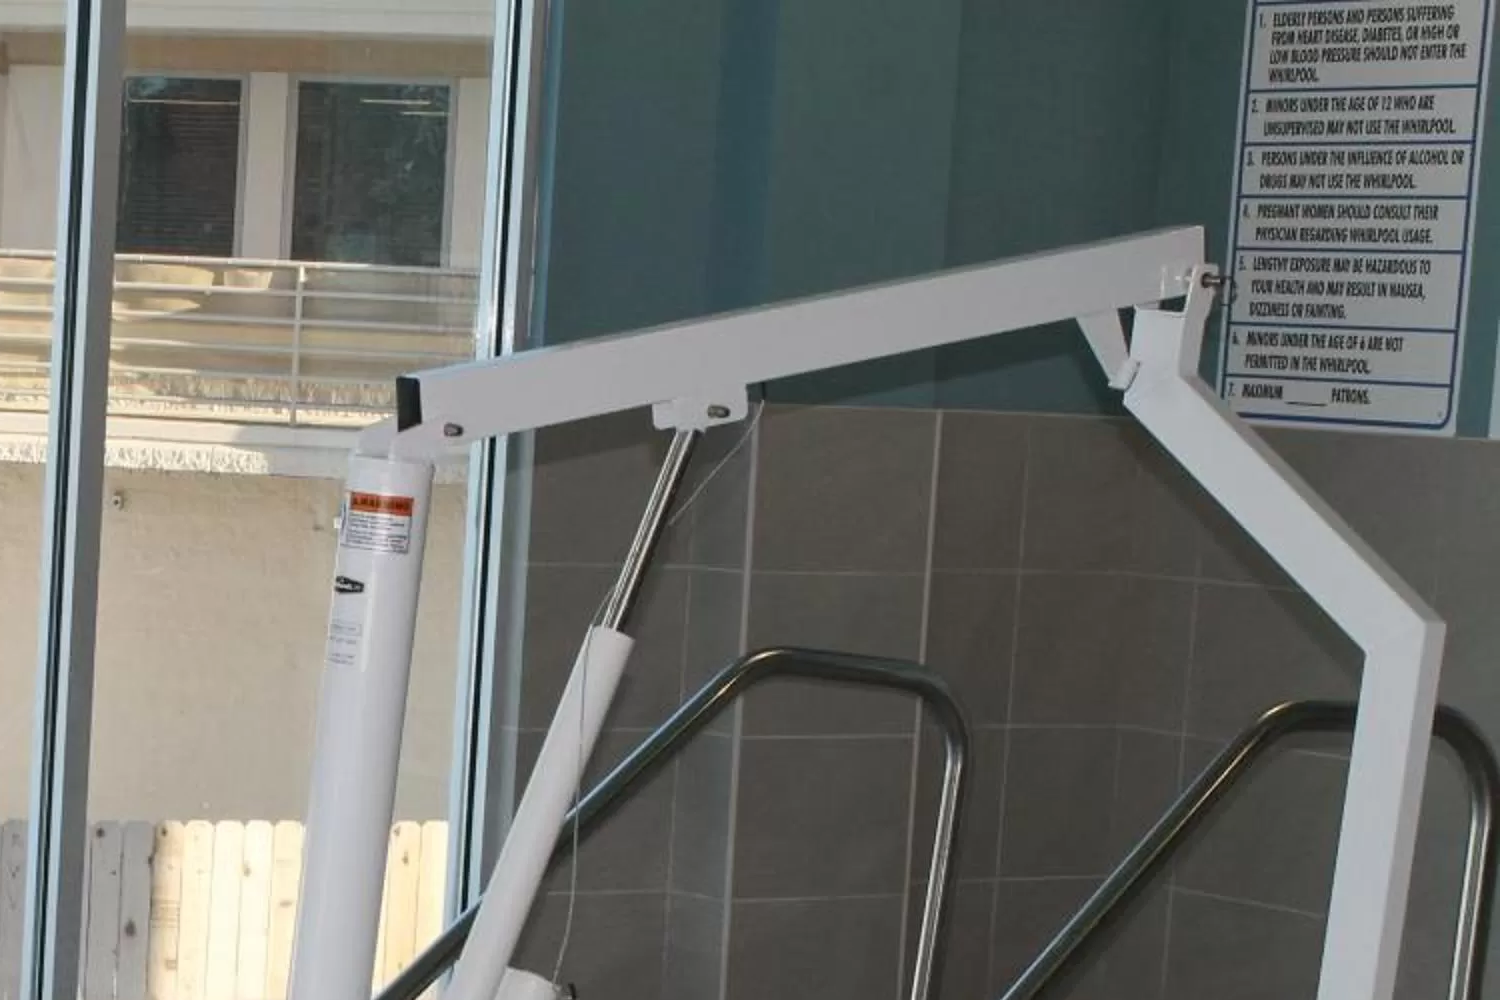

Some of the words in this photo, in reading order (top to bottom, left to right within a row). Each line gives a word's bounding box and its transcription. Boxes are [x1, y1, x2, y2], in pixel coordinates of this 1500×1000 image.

[1273, 11, 1306, 27] ELDERLY
[1308, 10, 1345, 26] PERSONS
[1347, 9, 1364, 24] AND
[1367, 8, 1404, 22] PERSONS
[1406, 5, 1455, 21] SUFFERING
[1272, 31, 1295, 45] FROM
[1298, 30, 1323, 44] HEART
[1406, 25, 1418, 41] OR
[1421, 24, 1444, 40] HIGH
[1447, 24, 1459, 39] OR
[1291, 49, 1319, 63] BLOOD
[1321, 47, 1361, 62] PRESSURE
[1363, 45, 1398, 61] SHOULD
[1400, 45, 1418, 60] NOT
[1420, 44, 1447, 60] ENTER
[1450, 43, 1466, 59] THE
[1266, 98, 1299, 112] MINORS
[1301, 97, 1329, 112] UNDER
[1331, 97, 1346, 112] THE
[1348, 96, 1364, 111] AGE
[1394, 95, 1416, 110] WHO
[1418, 95, 1435, 110] ARE
[1264, 121, 1324, 136] UNSUPERVISED
[1326, 120, 1344, 136] MAY
[1346, 120, 1363, 135] NOT
[1365, 120, 1381, 134] USE
[1383, 120, 1400, 135] THE
[1261, 151, 1298, 166] PERSONS
[1300, 151, 1328, 166] UNDER
[1329, 151, 1345, 166] THE
[1348, 150, 1392, 165] INFLUENCE
[1408, 149, 1449, 165] ALCOHOL
[1451, 149, 1464, 165] OR
[1260, 173, 1288, 189] DRUGS
[1290, 173, 1307, 189] MAY
[1308, 173, 1326, 188] NOT
[1328, 173, 1343, 189] USE
[1345, 173, 1361, 189] THE
[1257, 204, 1300, 219] PREGNANT
[1301, 204, 1335, 219] WOMEN
[1337, 204, 1371, 219] SHOULD
[1373, 204, 1412, 220] CONSULT
[1413, 204, 1439, 221] THEIR
[1255, 227, 1298, 241] PHYSICIAN
[1300, 227, 1348, 243] REGARDING
[1289, 257, 1331, 273] EXPOSURE
[1333, 258, 1350, 273] MAY
[1352, 258, 1363, 274] BE
[1365, 258, 1417, 275] HAZARDOUS
[1419, 259, 1431, 275] TO
[1251, 280, 1273, 294] YOUR
[1275, 280, 1305, 295] HEALTH
[1307, 280, 1325, 296] AND
[1326, 281, 1344, 296] MAY
[1346, 281, 1376, 297] RESULT
[1378, 283, 1388, 297] IN
[1389, 283, 1426, 301] NAUSEA,
[1249, 302, 1289, 317] DIZZINESS
[1291, 303, 1303, 319] OR
[1246, 331, 1279, 346] MINORS
[1280, 332, 1309, 348] UNDER
[1311, 333, 1326, 349] THE
[1328, 334, 1344, 349] AGE
[1368, 336, 1383, 351] ARE
[1386, 336, 1404, 352] NOT
[1245, 353, 1288, 370] PERMITTED
[1290, 356, 1300, 371] IN
[1302, 356, 1317, 372] THE
